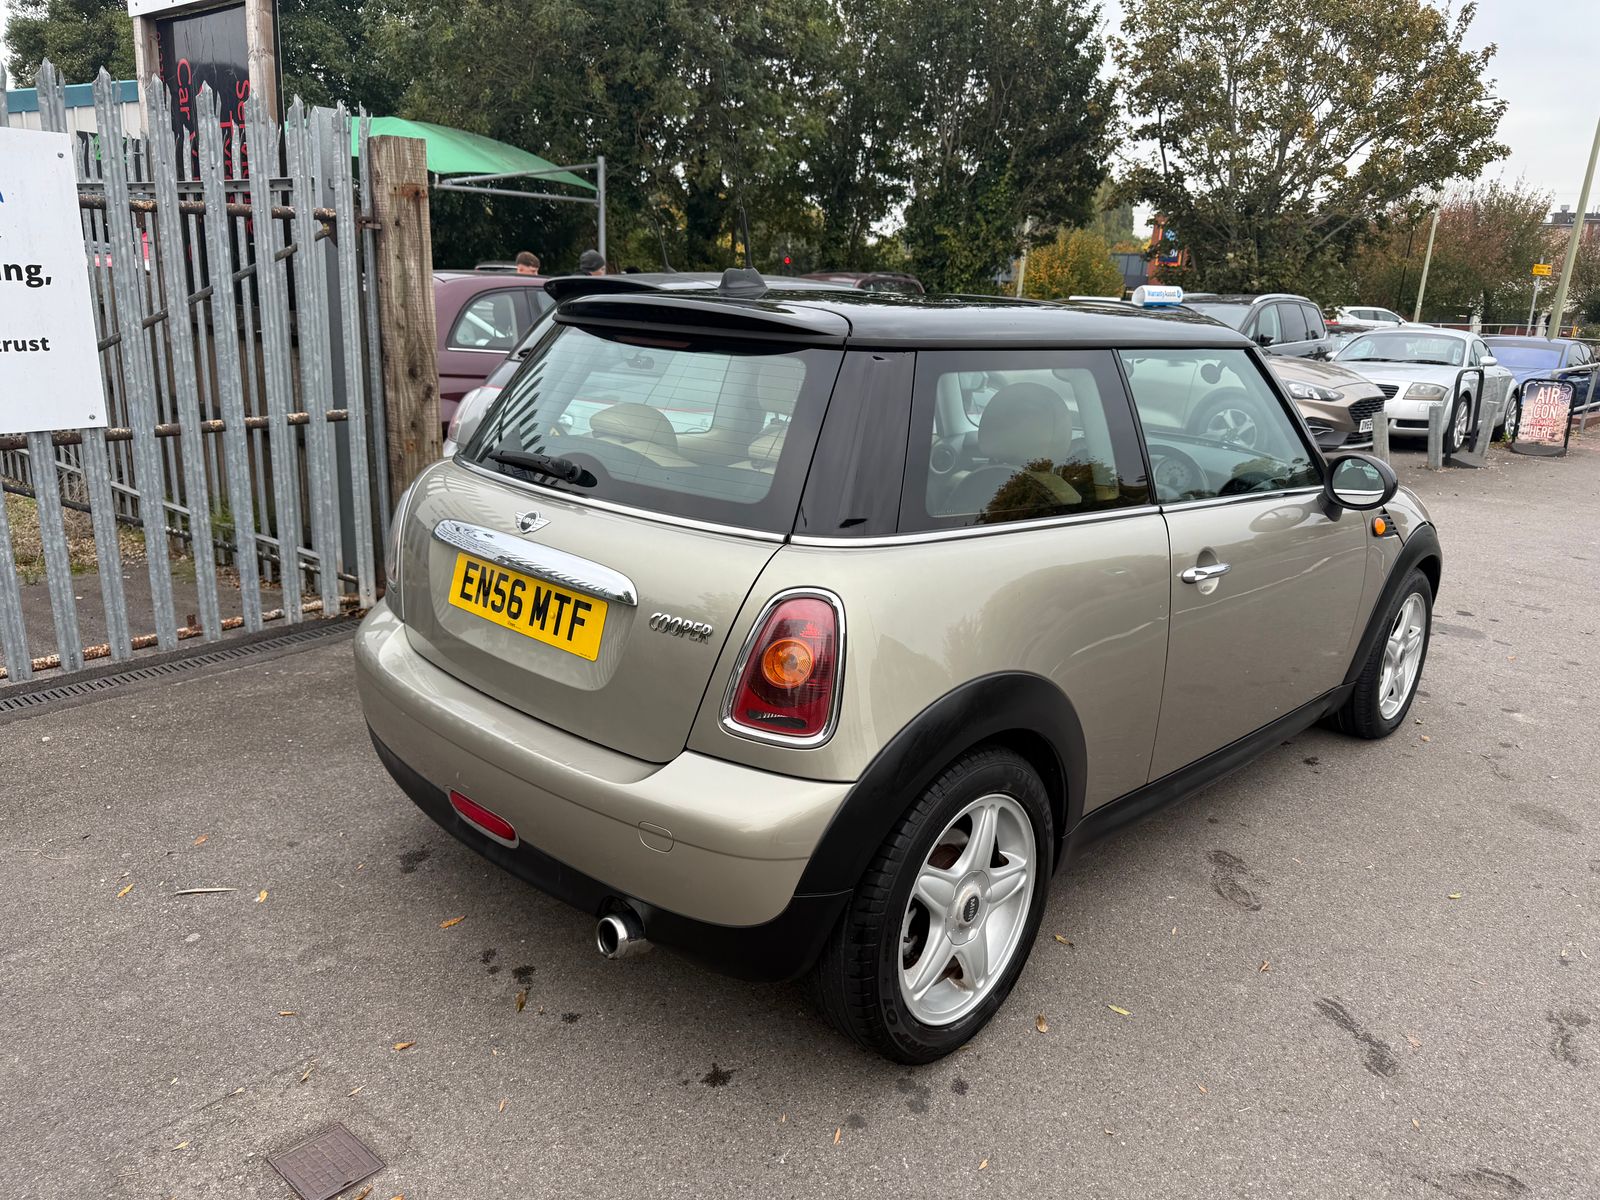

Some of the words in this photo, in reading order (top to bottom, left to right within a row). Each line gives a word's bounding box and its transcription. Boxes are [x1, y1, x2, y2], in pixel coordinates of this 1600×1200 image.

[176, 58, 192, 121] Car
[0, 263, 52, 288] ng,
[1535, 387, 1560, 404] AIR
[1533, 404, 1557, 419] CON
[1529, 426, 1553, 438] HERE
[460, 561, 526, 620] EN56
[529, 586, 592, 641] MTF
[650, 613, 713, 645] COOPER
